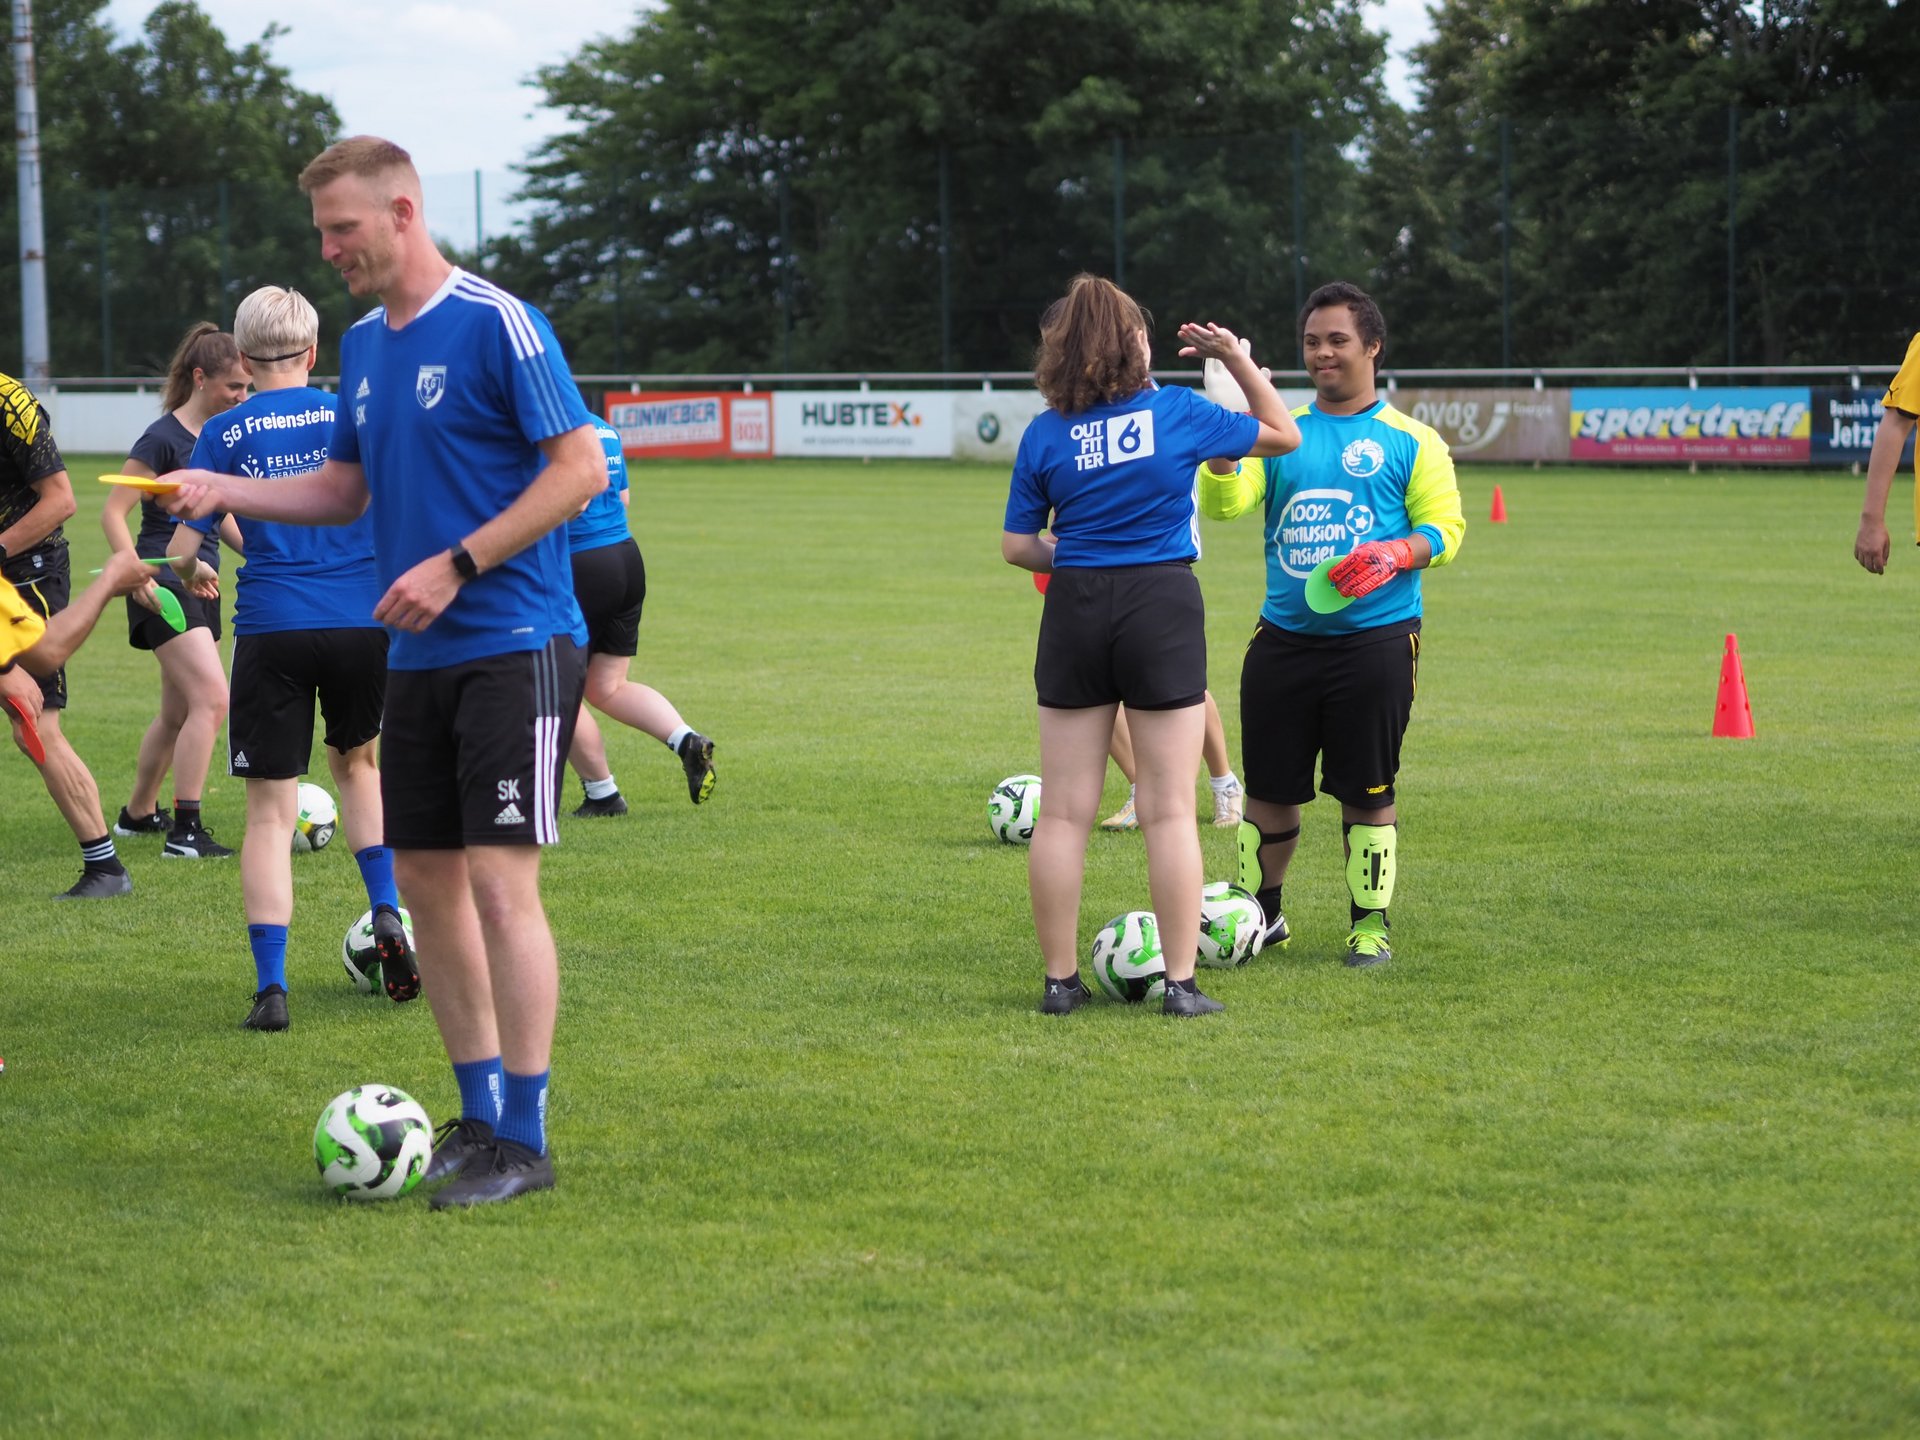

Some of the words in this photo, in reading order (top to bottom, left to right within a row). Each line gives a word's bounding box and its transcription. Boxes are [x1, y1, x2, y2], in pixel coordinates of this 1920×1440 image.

[613, 401, 718, 429] LEINWEBER
[1411, 401, 1480, 443] ovag
[1580, 402, 1807, 443] sport-treff
[222, 424, 243, 449] SG
[245, 405, 335, 434] Freienstein
[1070, 419, 1104, 441] OUT
[1080, 435, 1104, 455] FIT
[1074, 452, 1105, 472] TER
[1290, 503, 1332, 522] 100%
[497, 778, 521, 801] SK
[493, 815, 526, 825] adidas
